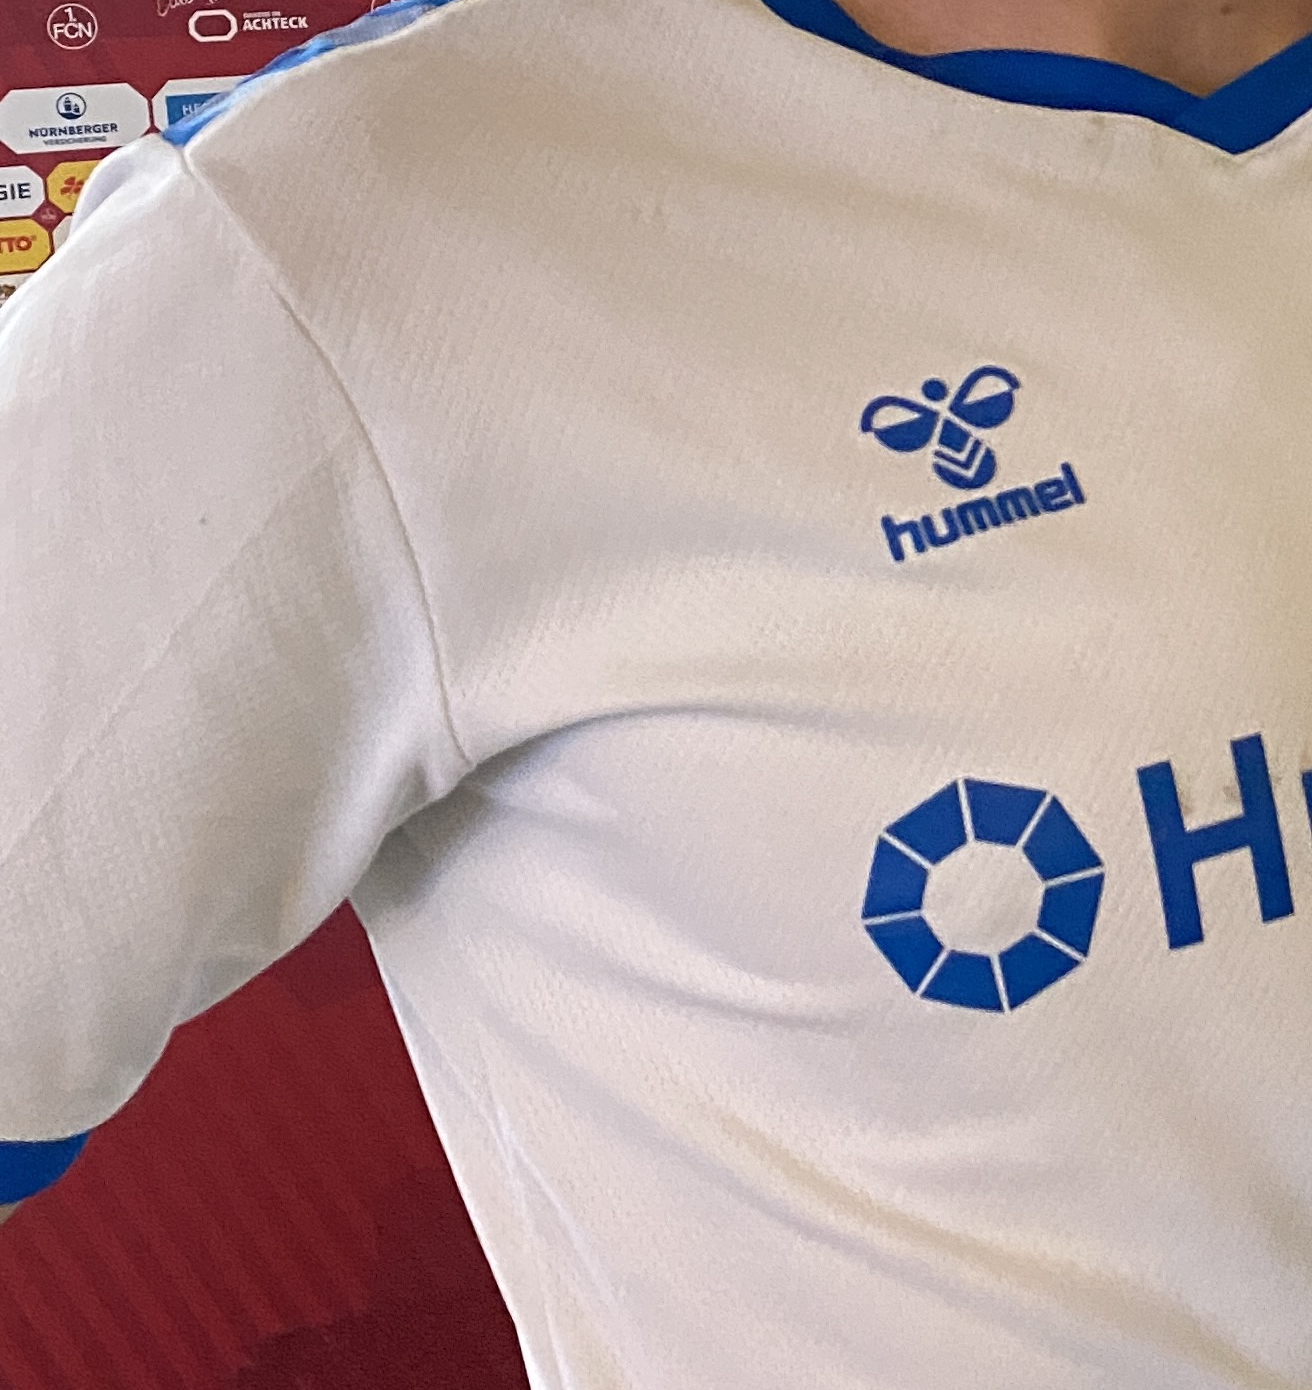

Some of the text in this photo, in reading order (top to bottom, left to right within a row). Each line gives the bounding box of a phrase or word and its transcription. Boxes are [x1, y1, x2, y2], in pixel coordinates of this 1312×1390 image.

[52, 22, 93, 41] FCN
[242, 16, 309, 31] ACHTECK
[28, 122, 119, 139] NÜRNBERGER
[880, 461, 1087, 563] hummel
